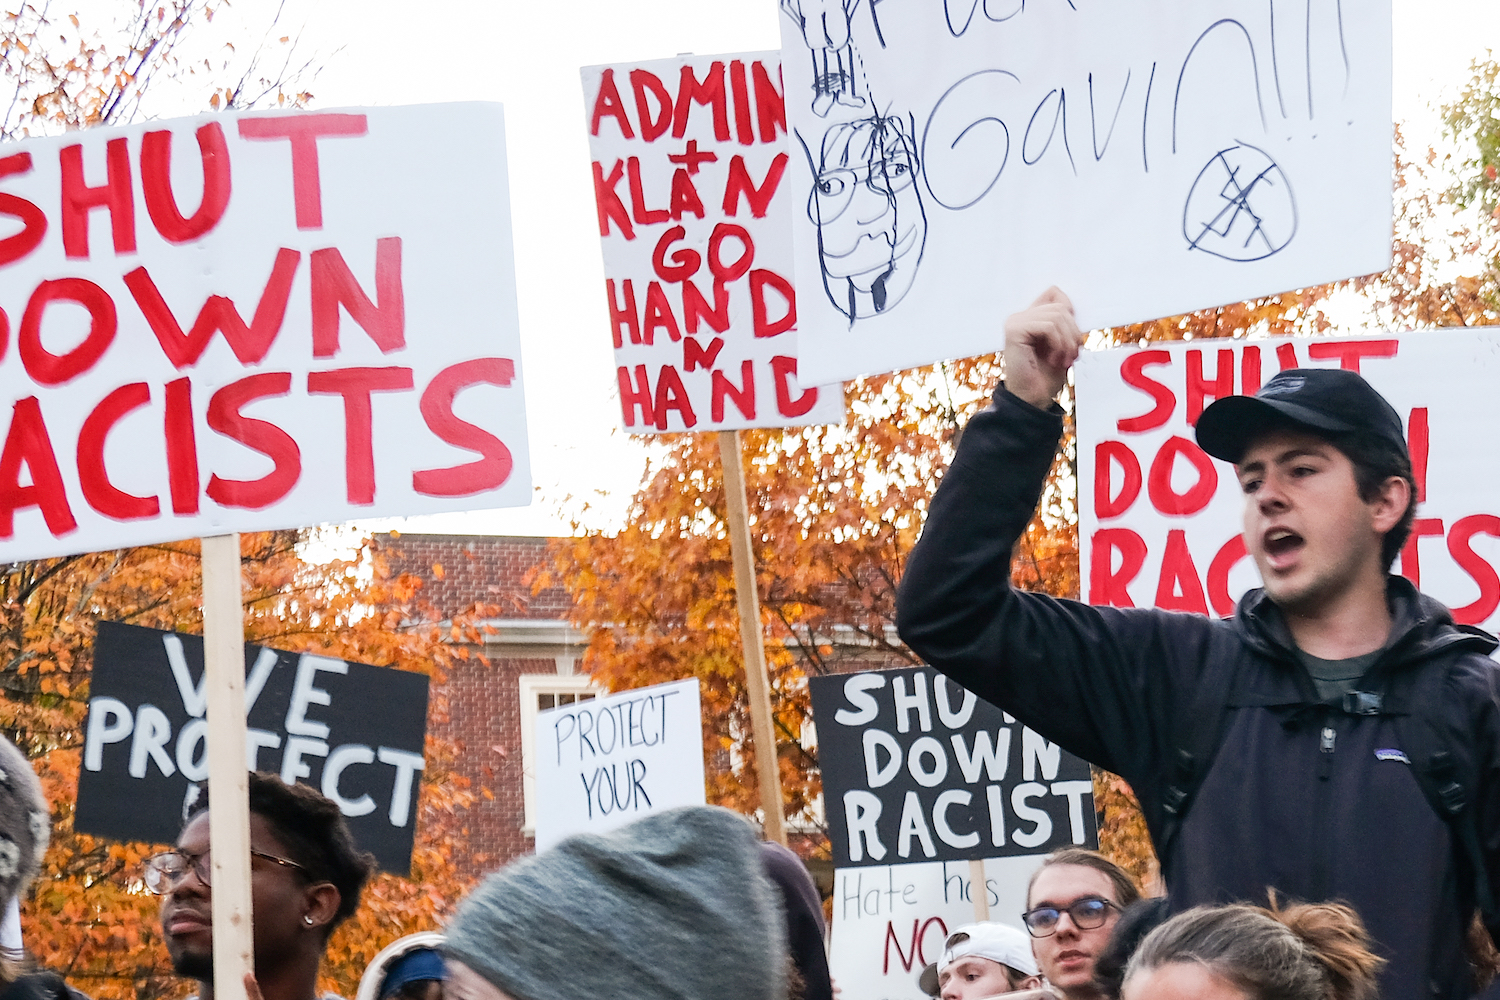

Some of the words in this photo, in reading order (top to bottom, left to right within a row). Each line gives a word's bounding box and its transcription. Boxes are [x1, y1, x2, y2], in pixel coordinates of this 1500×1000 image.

[590, 59, 789, 146] ADMIN
[0, 113, 368, 267] SHUT
[591, 151, 789, 241] KLAN
[651, 222, 755, 284] GO
[0, 236, 407, 387] OWN
[606, 269, 797, 349] HAND
[617, 355, 818, 431] HAND
[683, 336, 724, 373] N
[0, 358, 515, 540] ACISTS
[162, 633, 350, 741] WE
[834, 672, 1016, 734] SHU
[85, 697, 426, 828] PROTECT
[554, 690, 680, 767] PROTECT
[862, 725, 1061, 788] DOWN
[581, 758, 652, 821] YOUR
[843, 780, 1093, 862] RACIST
[843, 867, 918, 921] Hate
